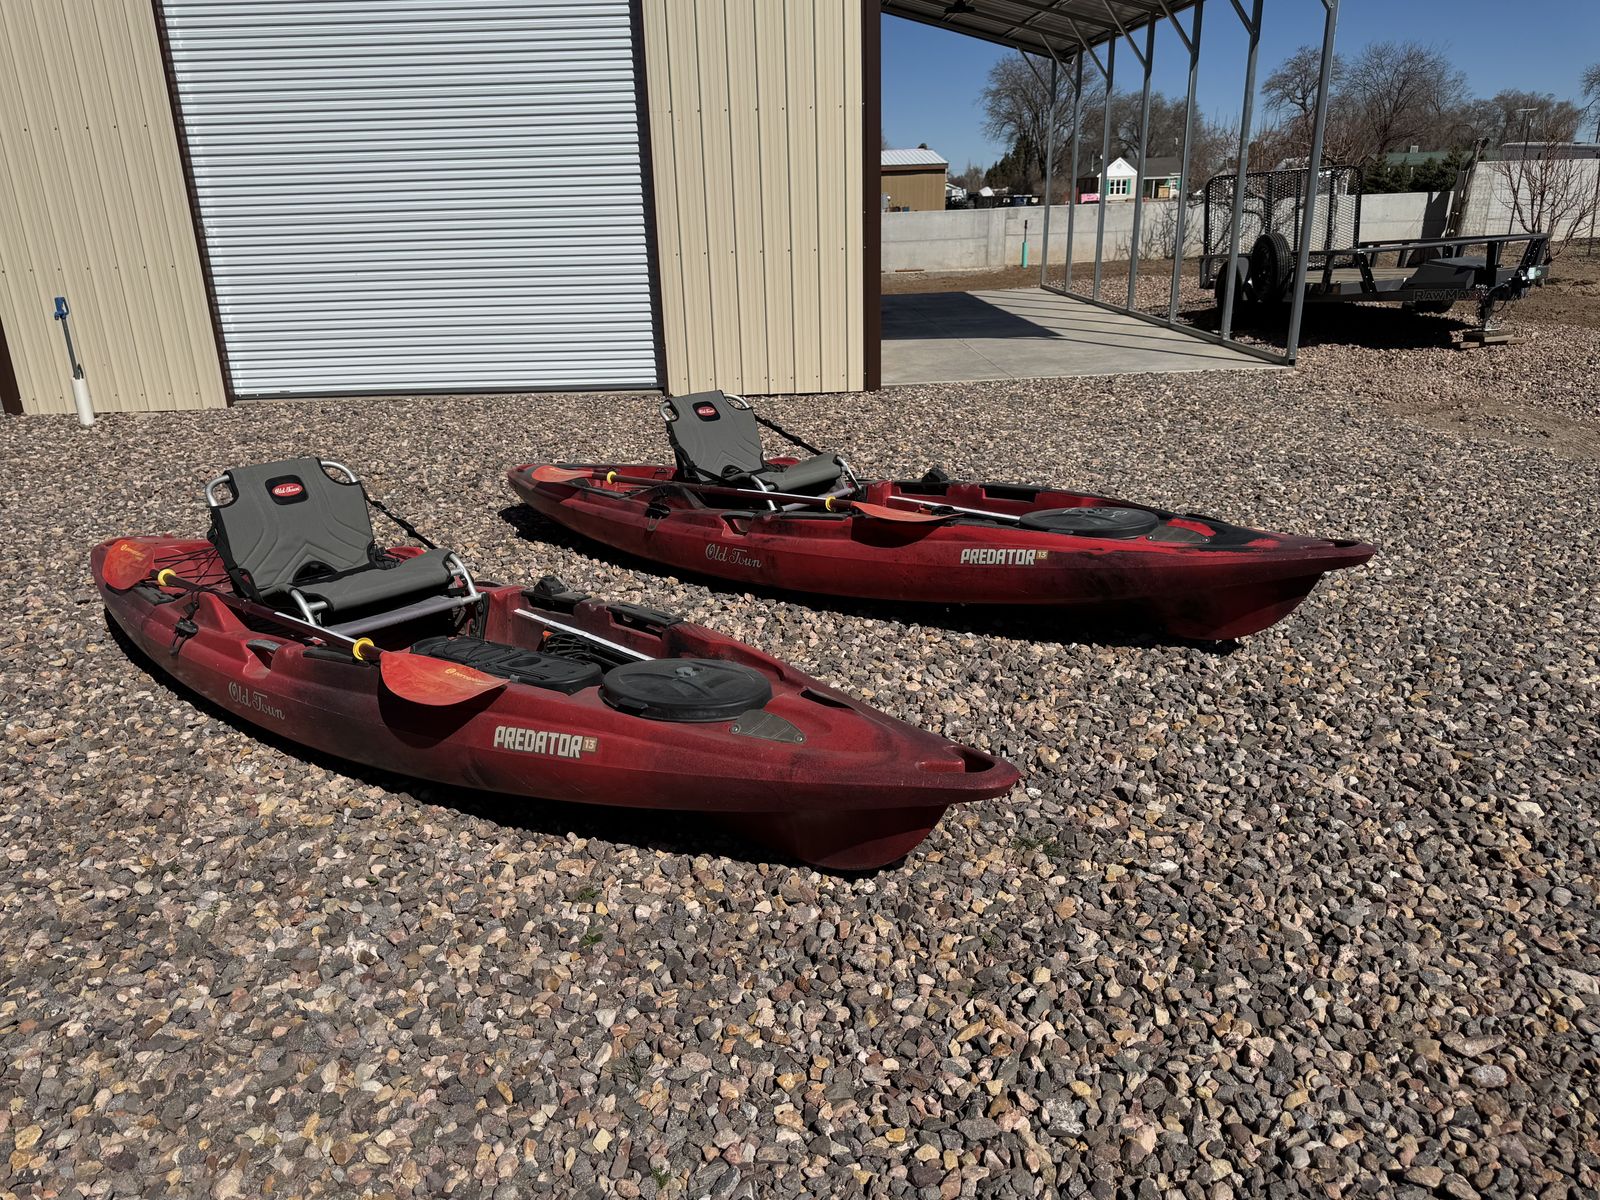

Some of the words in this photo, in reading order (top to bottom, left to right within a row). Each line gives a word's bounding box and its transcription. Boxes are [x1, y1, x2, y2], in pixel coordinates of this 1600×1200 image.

[705, 543, 728, 562] Old
[728, 547, 762, 568] Town
[960, 548, 1036, 565] PREDATOR
[228, 681, 251, 708] Old
[252, 690, 286, 720] Town
[493, 725, 583, 758] PREDATOR
[584, 739, 596, 750] 13
